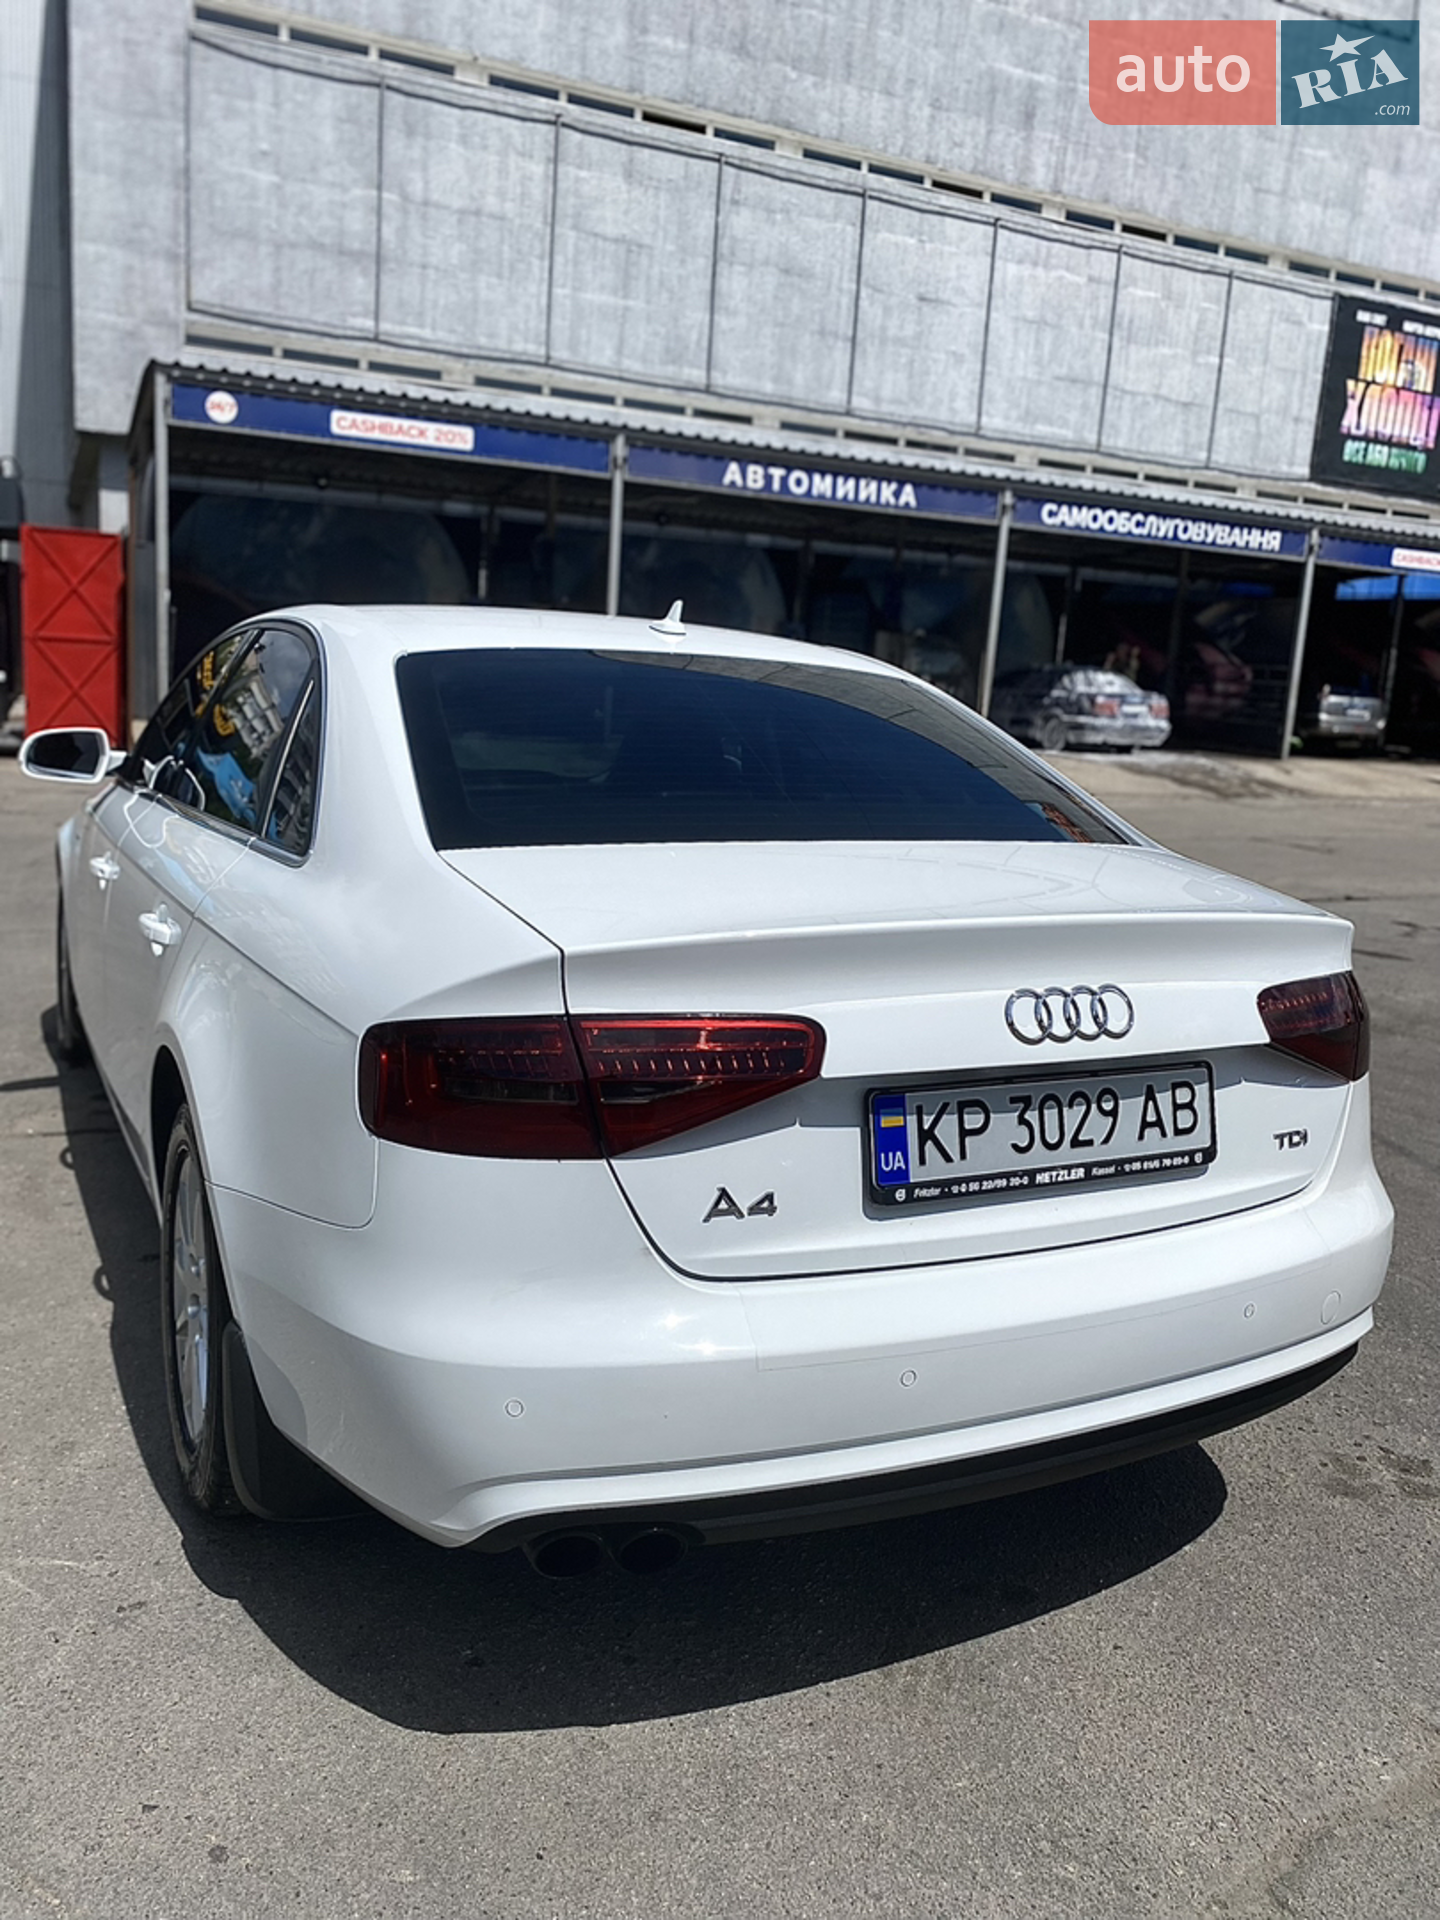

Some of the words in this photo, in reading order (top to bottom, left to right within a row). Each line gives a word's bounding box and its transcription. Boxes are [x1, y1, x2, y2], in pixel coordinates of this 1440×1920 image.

[335, 414, 427, 440] CASHBACK
[433, 428, 469, 445] 20%
[1040, 502, 1283, 552] САМООБСЛУГОВУВАННЯ
[915, 1098, 991, 1167] KP
[1009, 1087, 1119, 1154] 3029
[1137, 1080, 1199, 1141] AB
[880, 1151, 907, 1172] UA
[1035, 1167, 1085, 1185] HETZLER
[702, 1186, 777, 1223] A4
